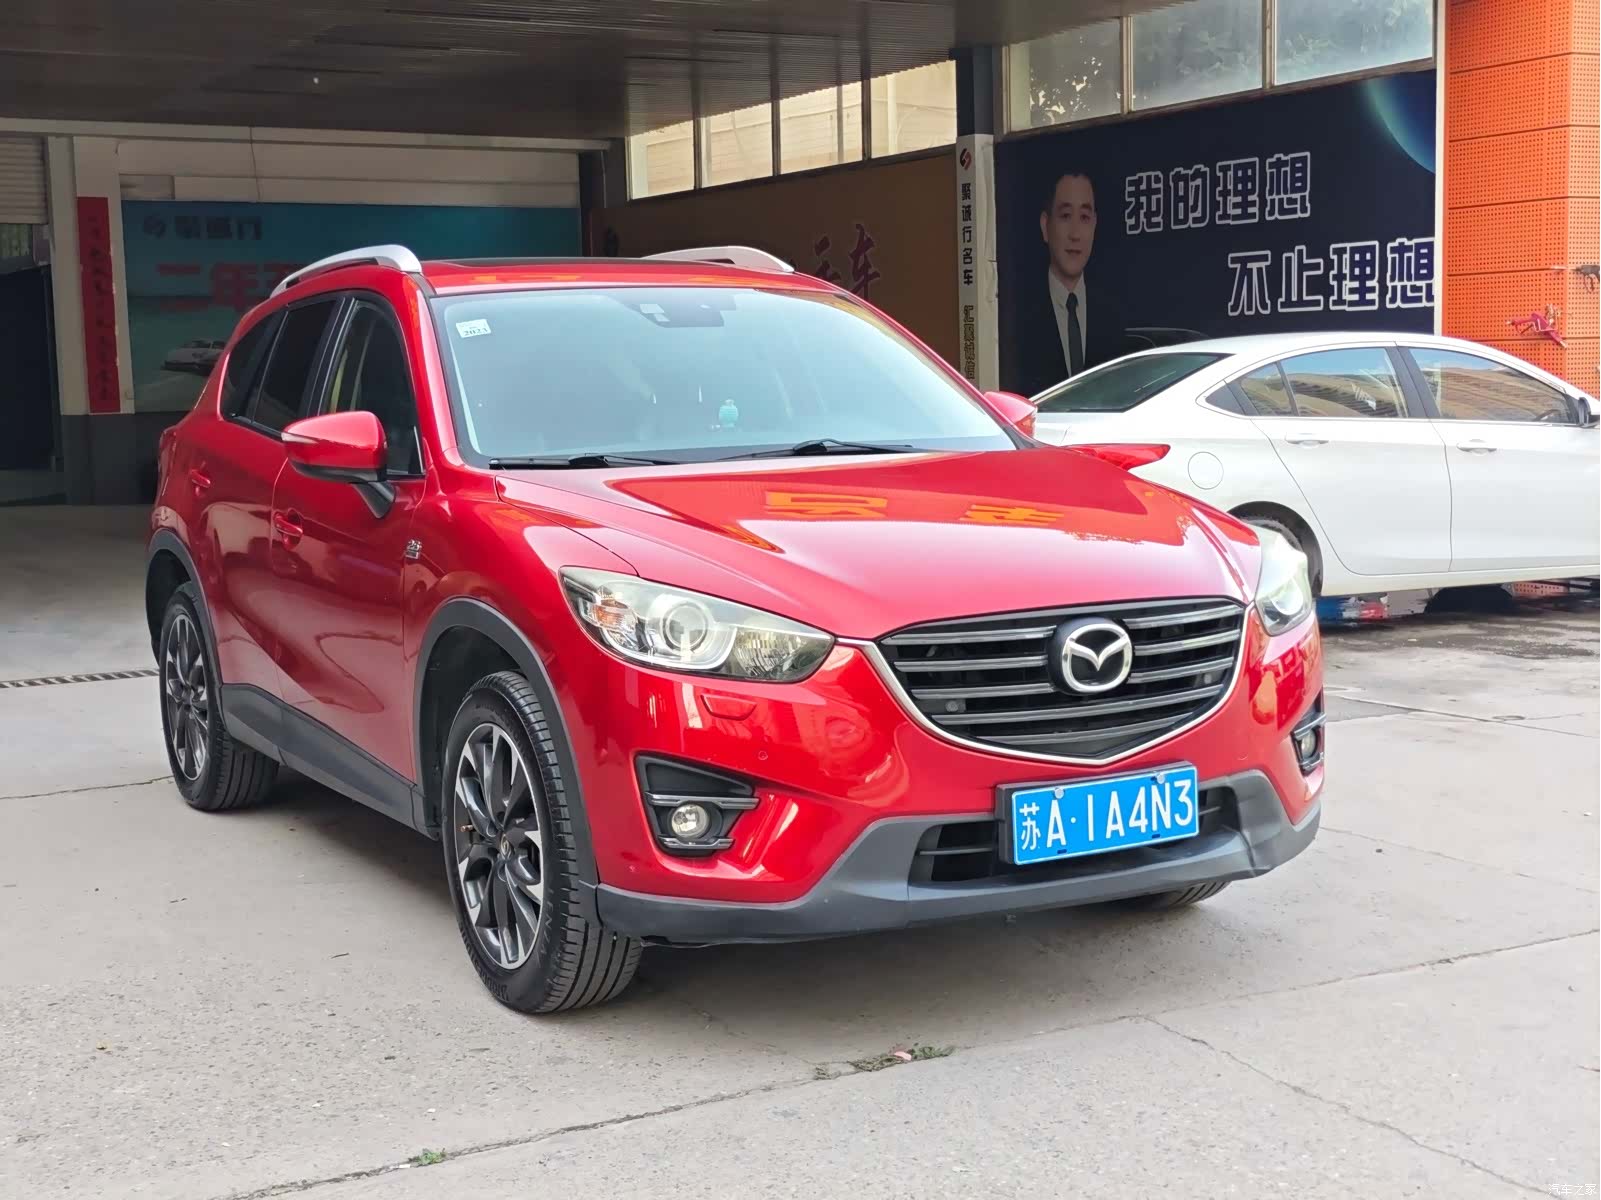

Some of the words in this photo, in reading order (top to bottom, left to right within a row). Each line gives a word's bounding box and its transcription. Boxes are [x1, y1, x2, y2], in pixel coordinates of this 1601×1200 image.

[961, 182, 973, 285] 聚诚行名车
[1125, 152, 1310, 234] 我的理想
[1228, 237, 1435, 316] 不止理想
